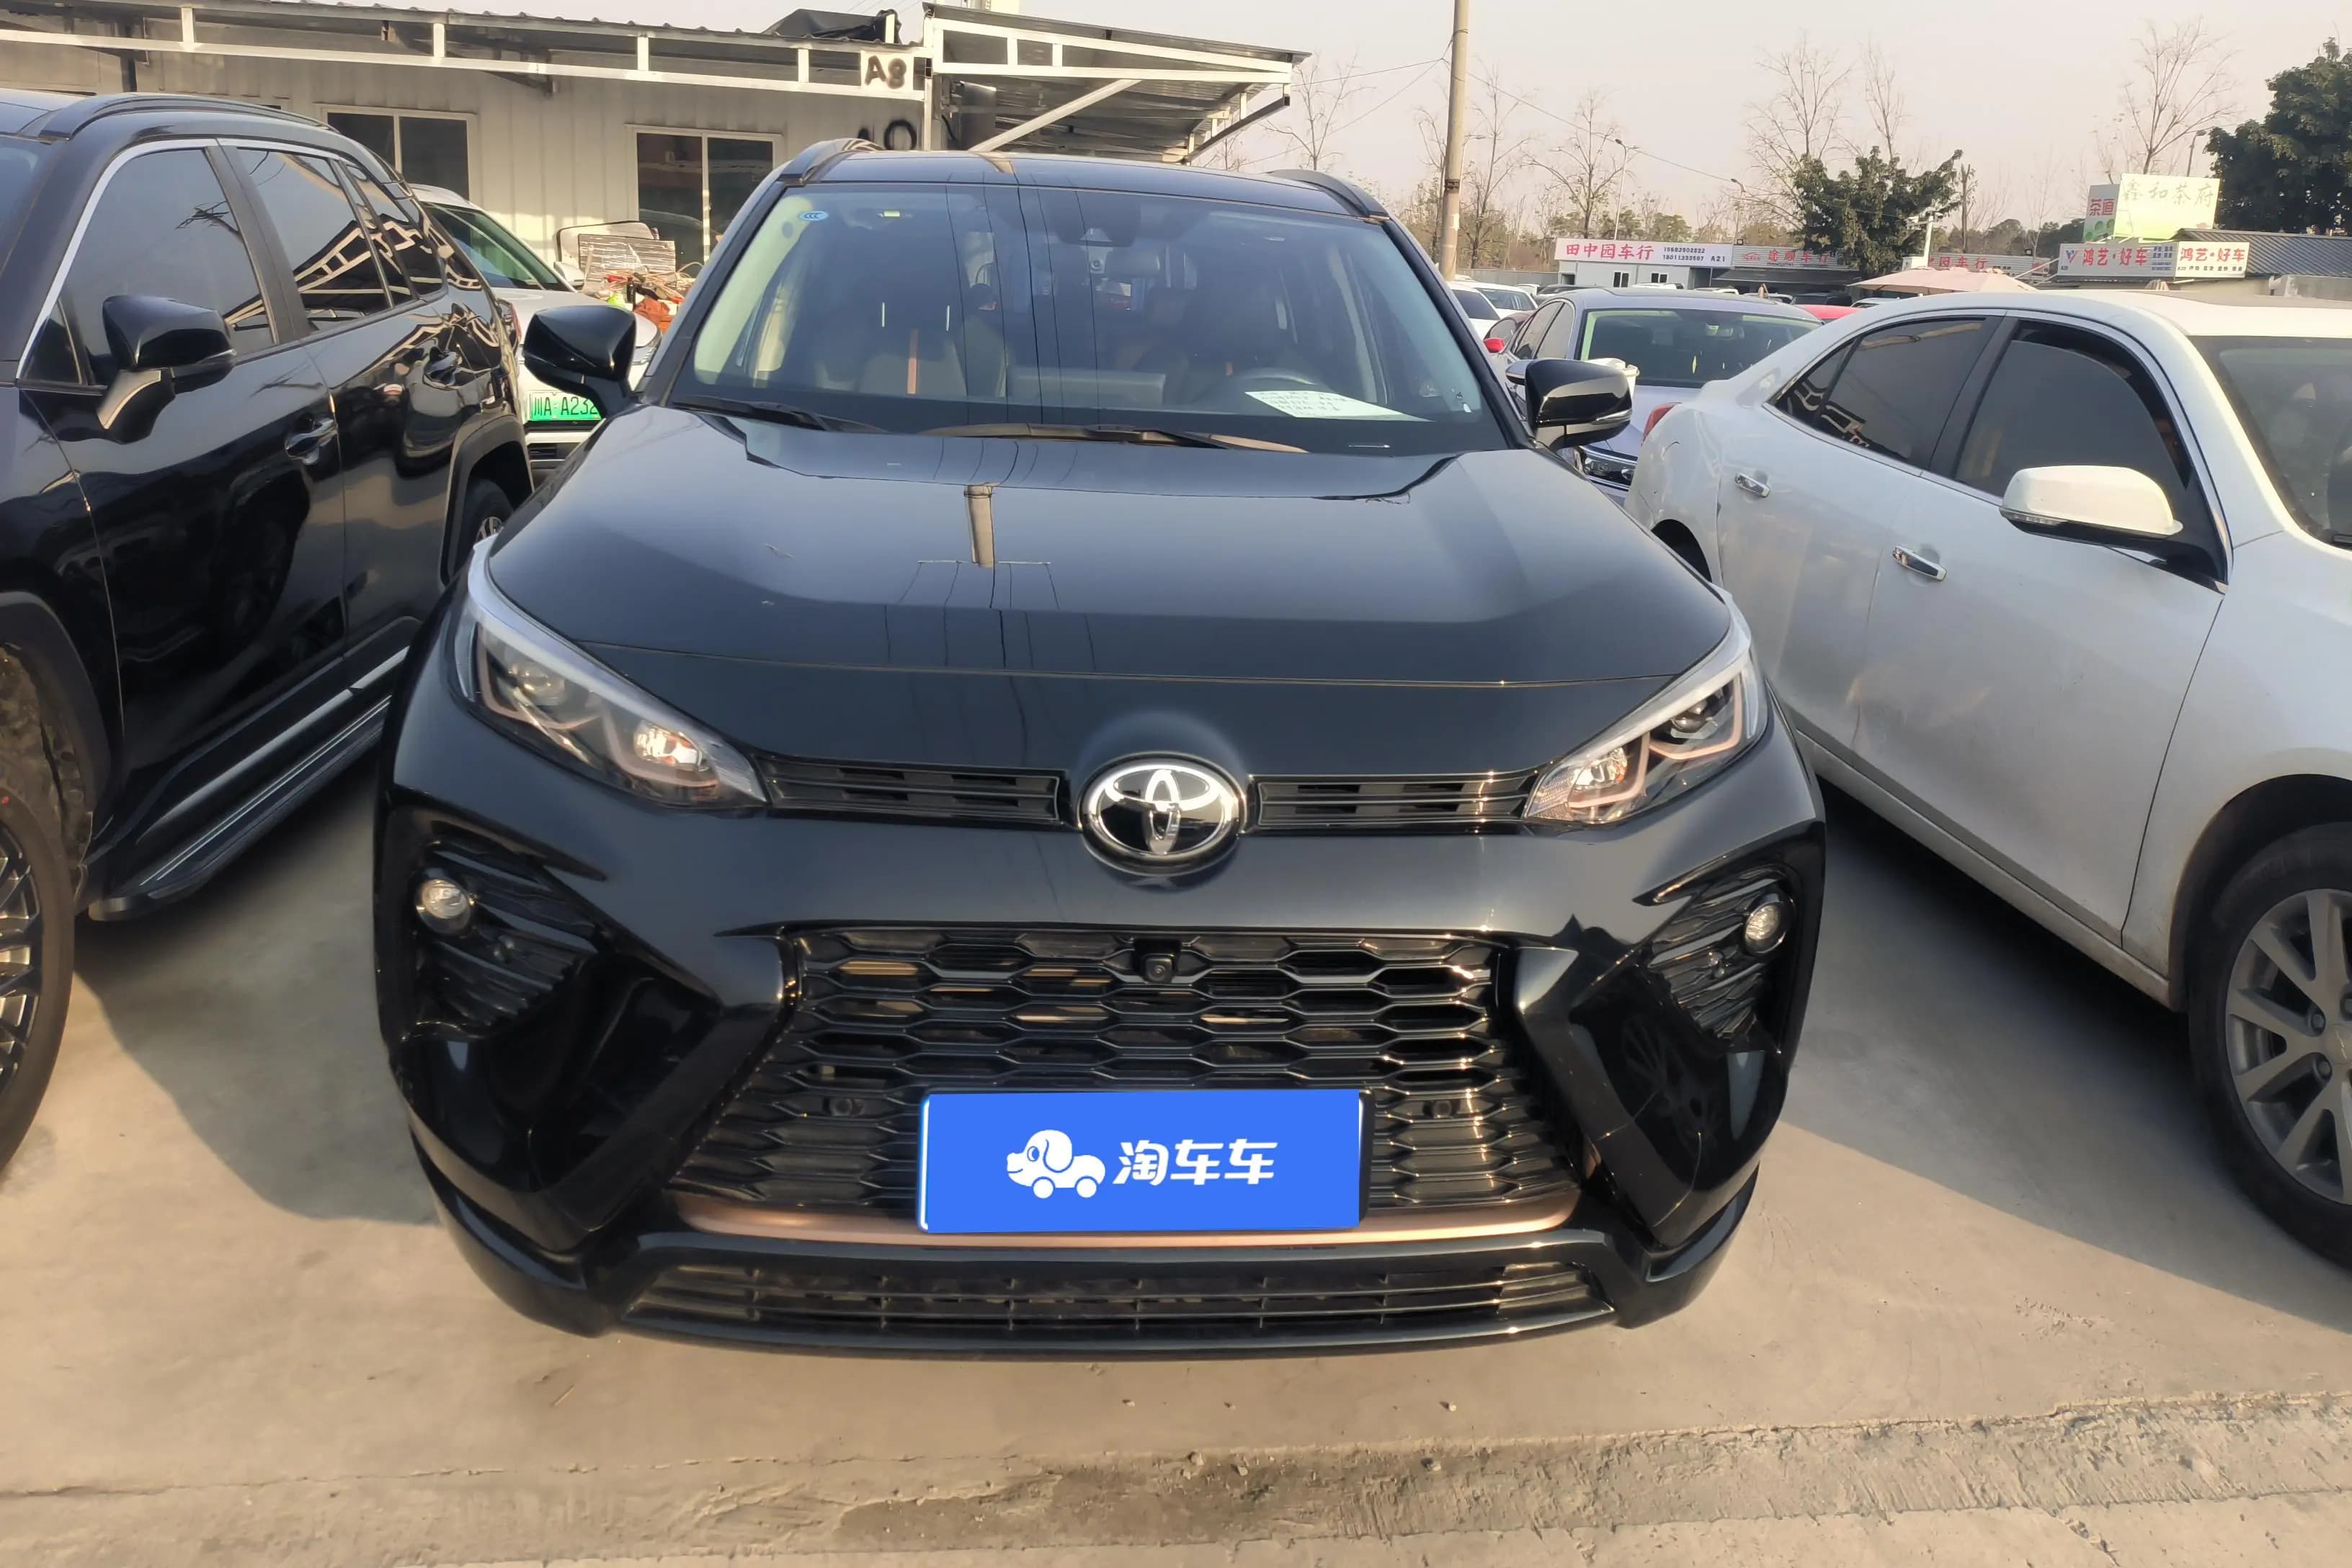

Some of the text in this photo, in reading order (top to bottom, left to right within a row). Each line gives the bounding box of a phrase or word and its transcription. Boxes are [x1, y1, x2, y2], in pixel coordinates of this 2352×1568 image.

[1566, 243, 1654, 260] 田中园车行
